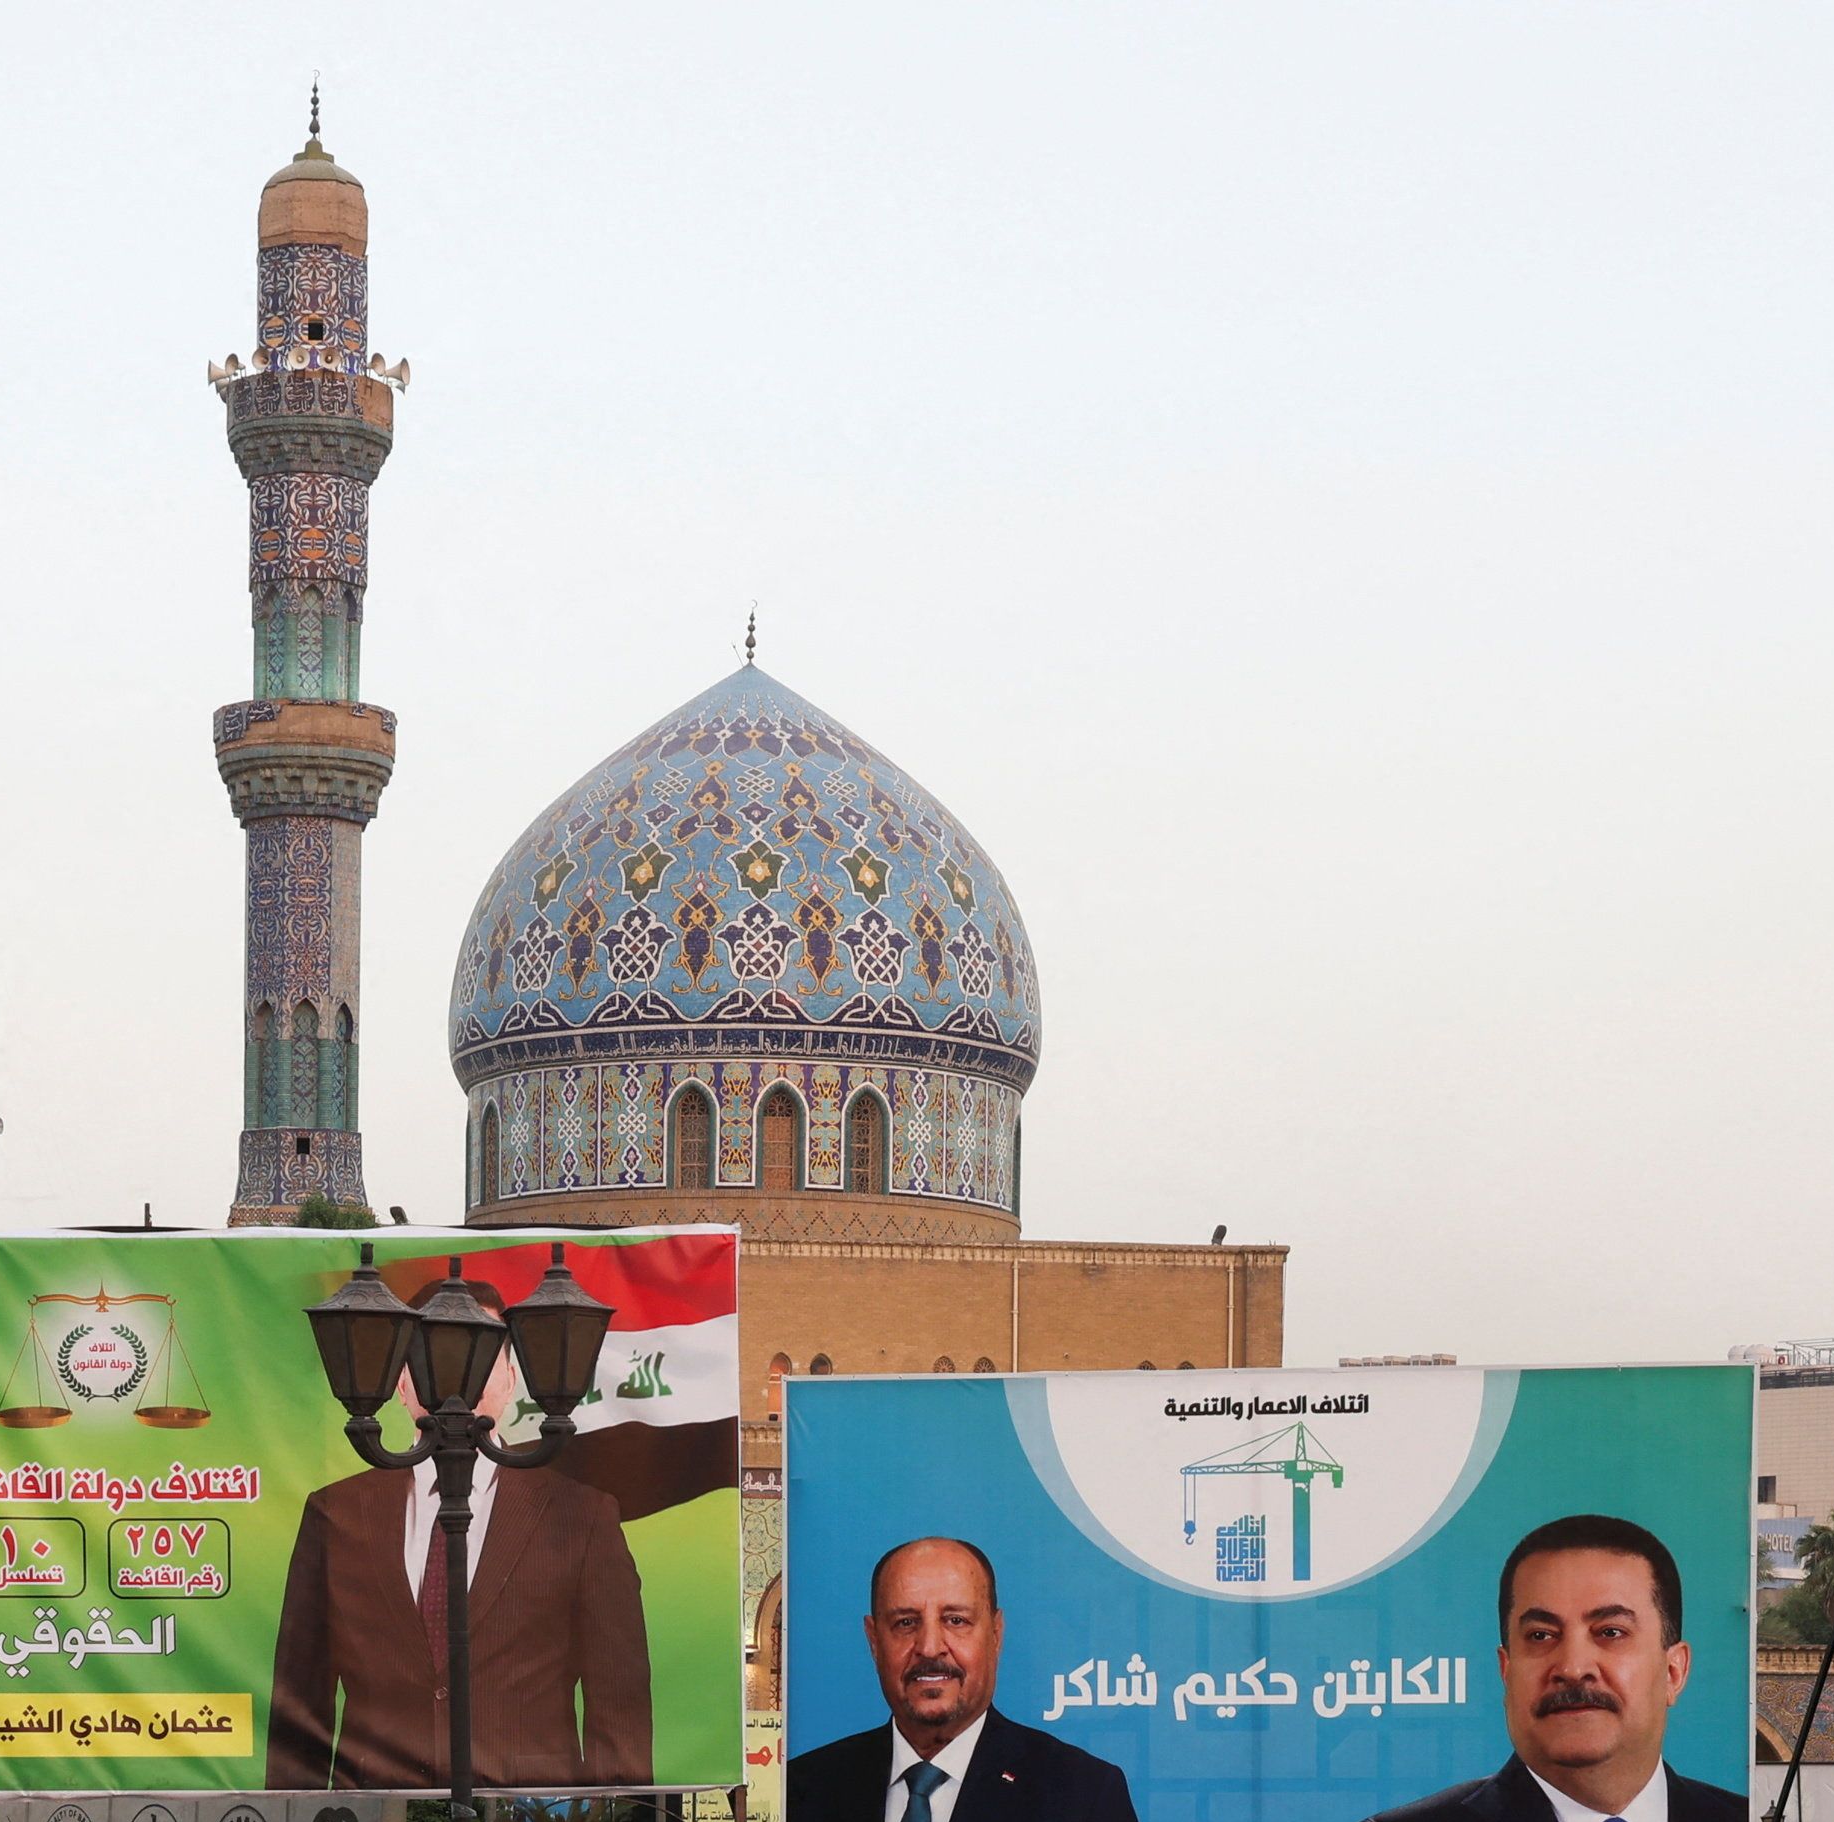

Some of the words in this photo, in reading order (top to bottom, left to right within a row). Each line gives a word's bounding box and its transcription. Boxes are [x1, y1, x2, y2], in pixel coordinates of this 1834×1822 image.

[73, 1359, 107, 1371] القانون
[110, 1360, 133, 1371] دولة
[1163, 1396, 1244, 1422] والتنمية
[1247, 1394, 1308, 1421] الاعمار
[1310, 1393, 1370, 1415] ائتلاف
[70, 1467, 147, 1514] دولة
[149, 1463, 260, 1503] ائتلاف
[118, 1567, 185, 1589] القائمة
[185, 1565, 225, 1597] رقم
[1042, 1653, 1158, 1721] شاكر
[1172, 1657, 1298, 1721] حكيم
[1312, 1655, 1467, 1719] الكابتن
[70, 1708, 142, 1747] هادي
[148, 1704, 233, 1740] عثمان
[68, 1809, 77, 1819] OF
